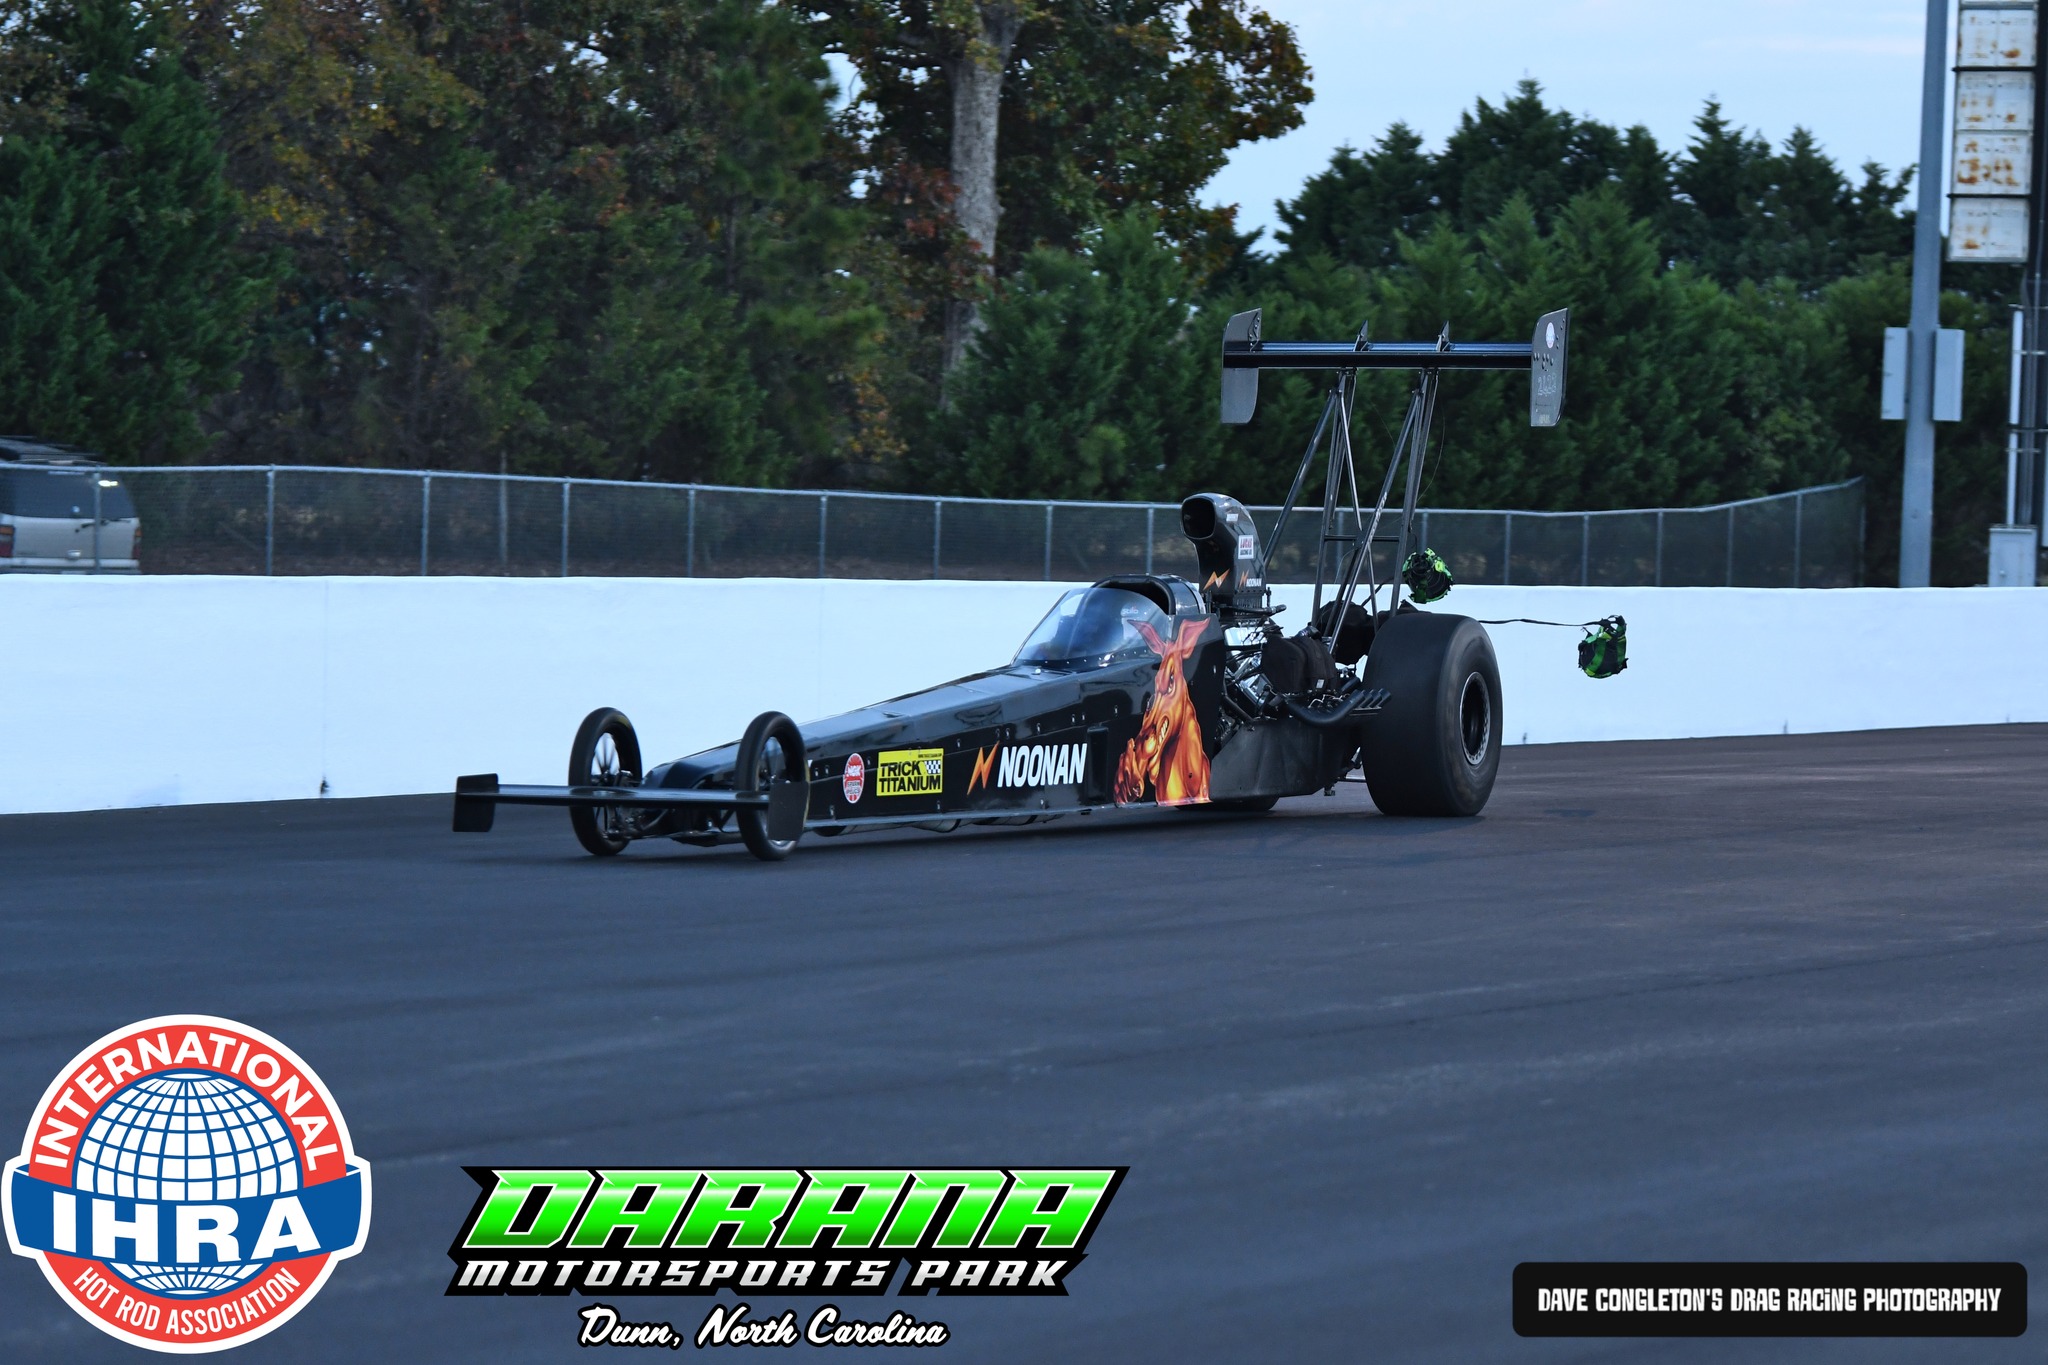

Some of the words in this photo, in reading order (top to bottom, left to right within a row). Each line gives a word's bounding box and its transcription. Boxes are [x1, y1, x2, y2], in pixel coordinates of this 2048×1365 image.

[880, 760, 922, 777] TRICK
[997, 743, 1087, 787] NOONAN
[879, 775, 940, 792] TITANIUM
